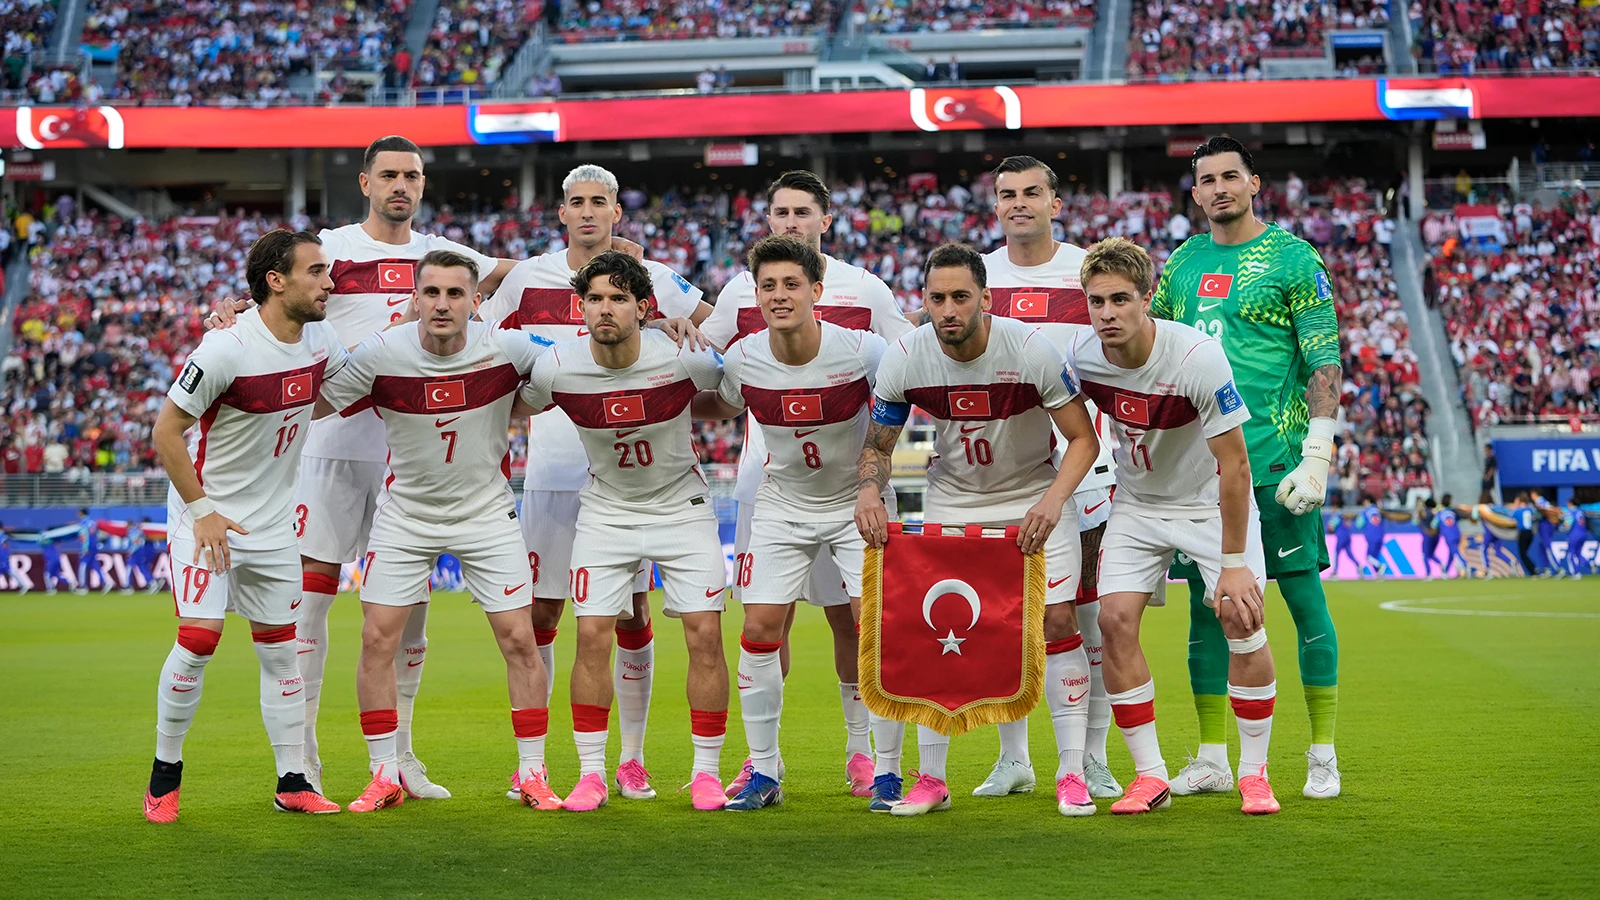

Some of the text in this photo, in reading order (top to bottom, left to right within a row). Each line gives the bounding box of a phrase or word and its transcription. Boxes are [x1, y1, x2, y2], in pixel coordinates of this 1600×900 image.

[273, 423, 299, 458] 19
[440, 430, 458, 464] 7
[613, 440, 654, 469] 20
[802, 441, 823, 469] 8
[960, 437, 994, 467] 10
[1129, 438, 1153, 471] 11
[1532, 448, 1590, 472] FIFA
[296, 504, 309, 538] 3
[182, 566, 210, 604] 19
[362, 551, 376, 587] 7
